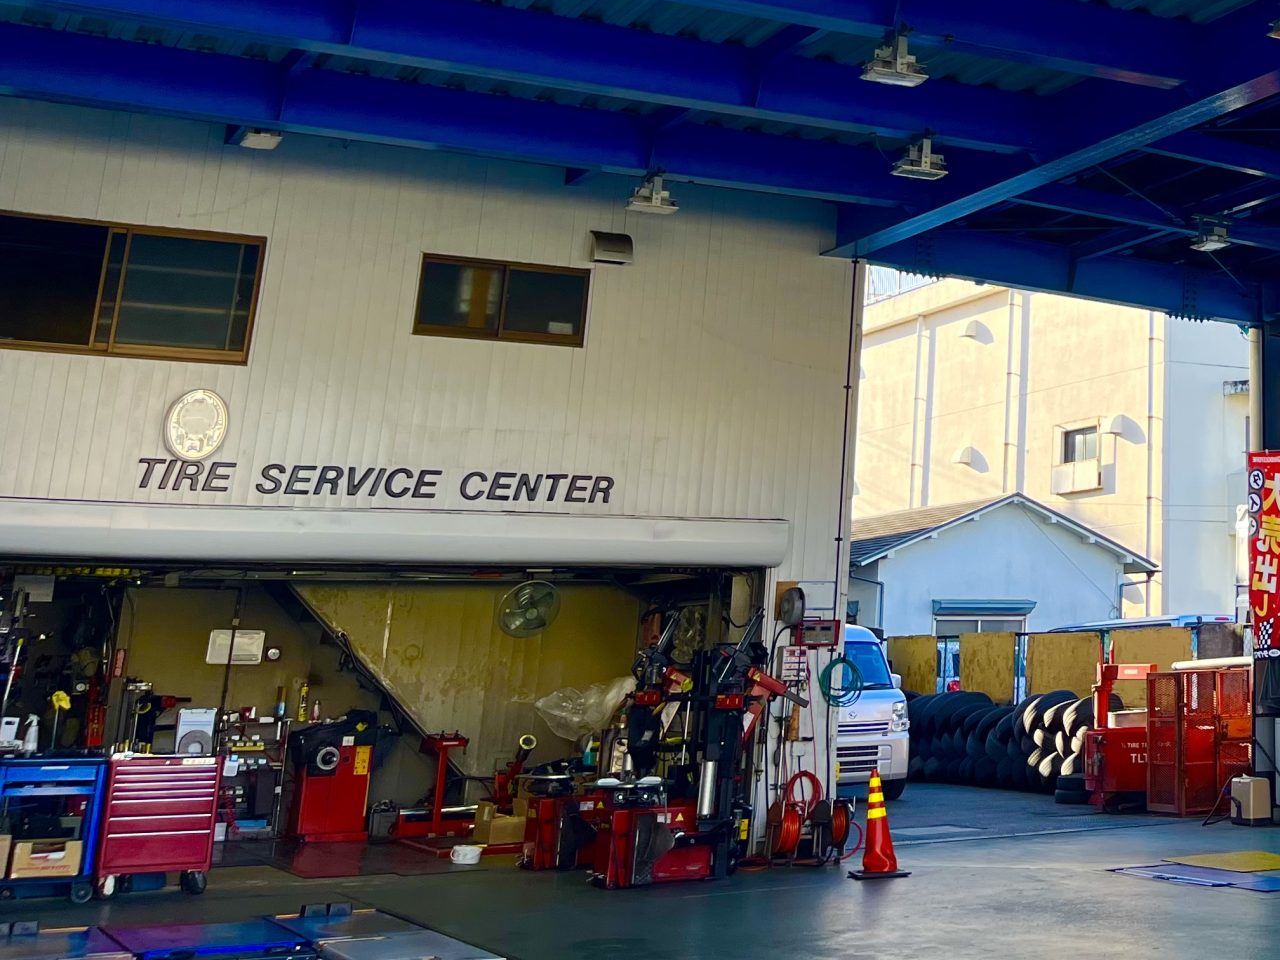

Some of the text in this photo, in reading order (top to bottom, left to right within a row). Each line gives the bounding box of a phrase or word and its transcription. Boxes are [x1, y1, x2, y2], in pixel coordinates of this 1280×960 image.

[137, 458, 615, 504] TIRE SERVICE CENTER
